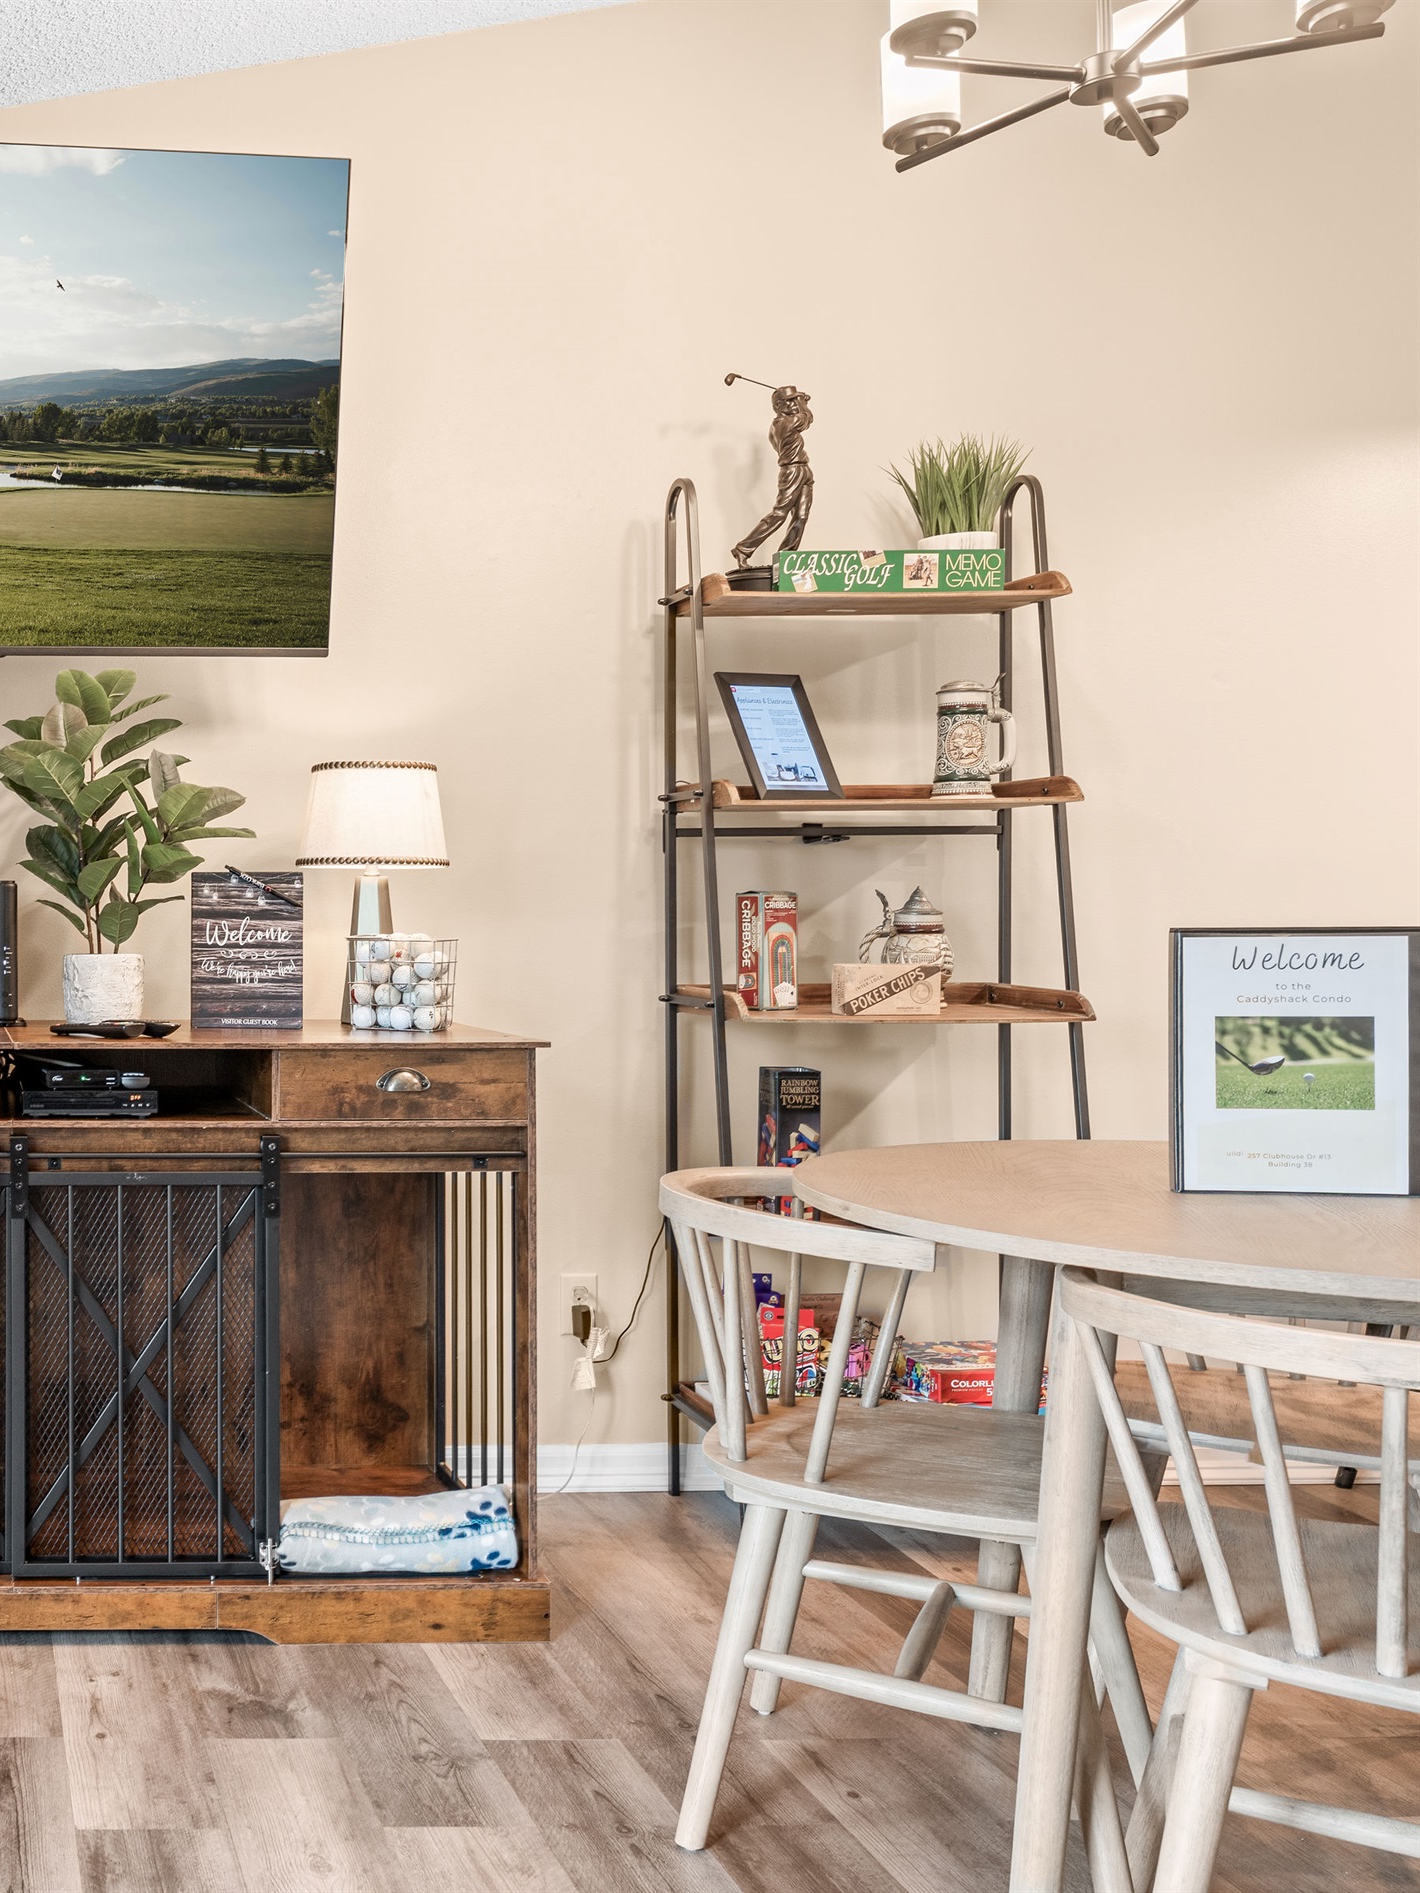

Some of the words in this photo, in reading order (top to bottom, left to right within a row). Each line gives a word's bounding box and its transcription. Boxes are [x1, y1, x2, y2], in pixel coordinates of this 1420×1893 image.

[783, 553, 857, 576] CLASSIC
[945, 553, 1001, 571] MEMO
[844, 564, 895, 591] GOLF
[945, 570, 1001, 587] GAME
[764, 901, 796, 909] CRIBBAGE
[206, 916, 293, 946] Welcome
[741, 899, 751, 968] CRIBBAGE
[1232, 943, 1365, 971] Welcome
[850, 986, 890, 1013] POKER
[890, 967, 925, 993] CHIPS
[1275, 983, 1287, 991] to
[1291, 982, 1312, 991] the
[1236, 994, 1308, 1005] Caddyshack
[1312, 994, 1352, 1003] Condo
[780, 1086, 819, 1094] JUMBLING
[781, 1079, 819, 1087] RAINBOW
[780, 1094, 820, 1105] TOWER
